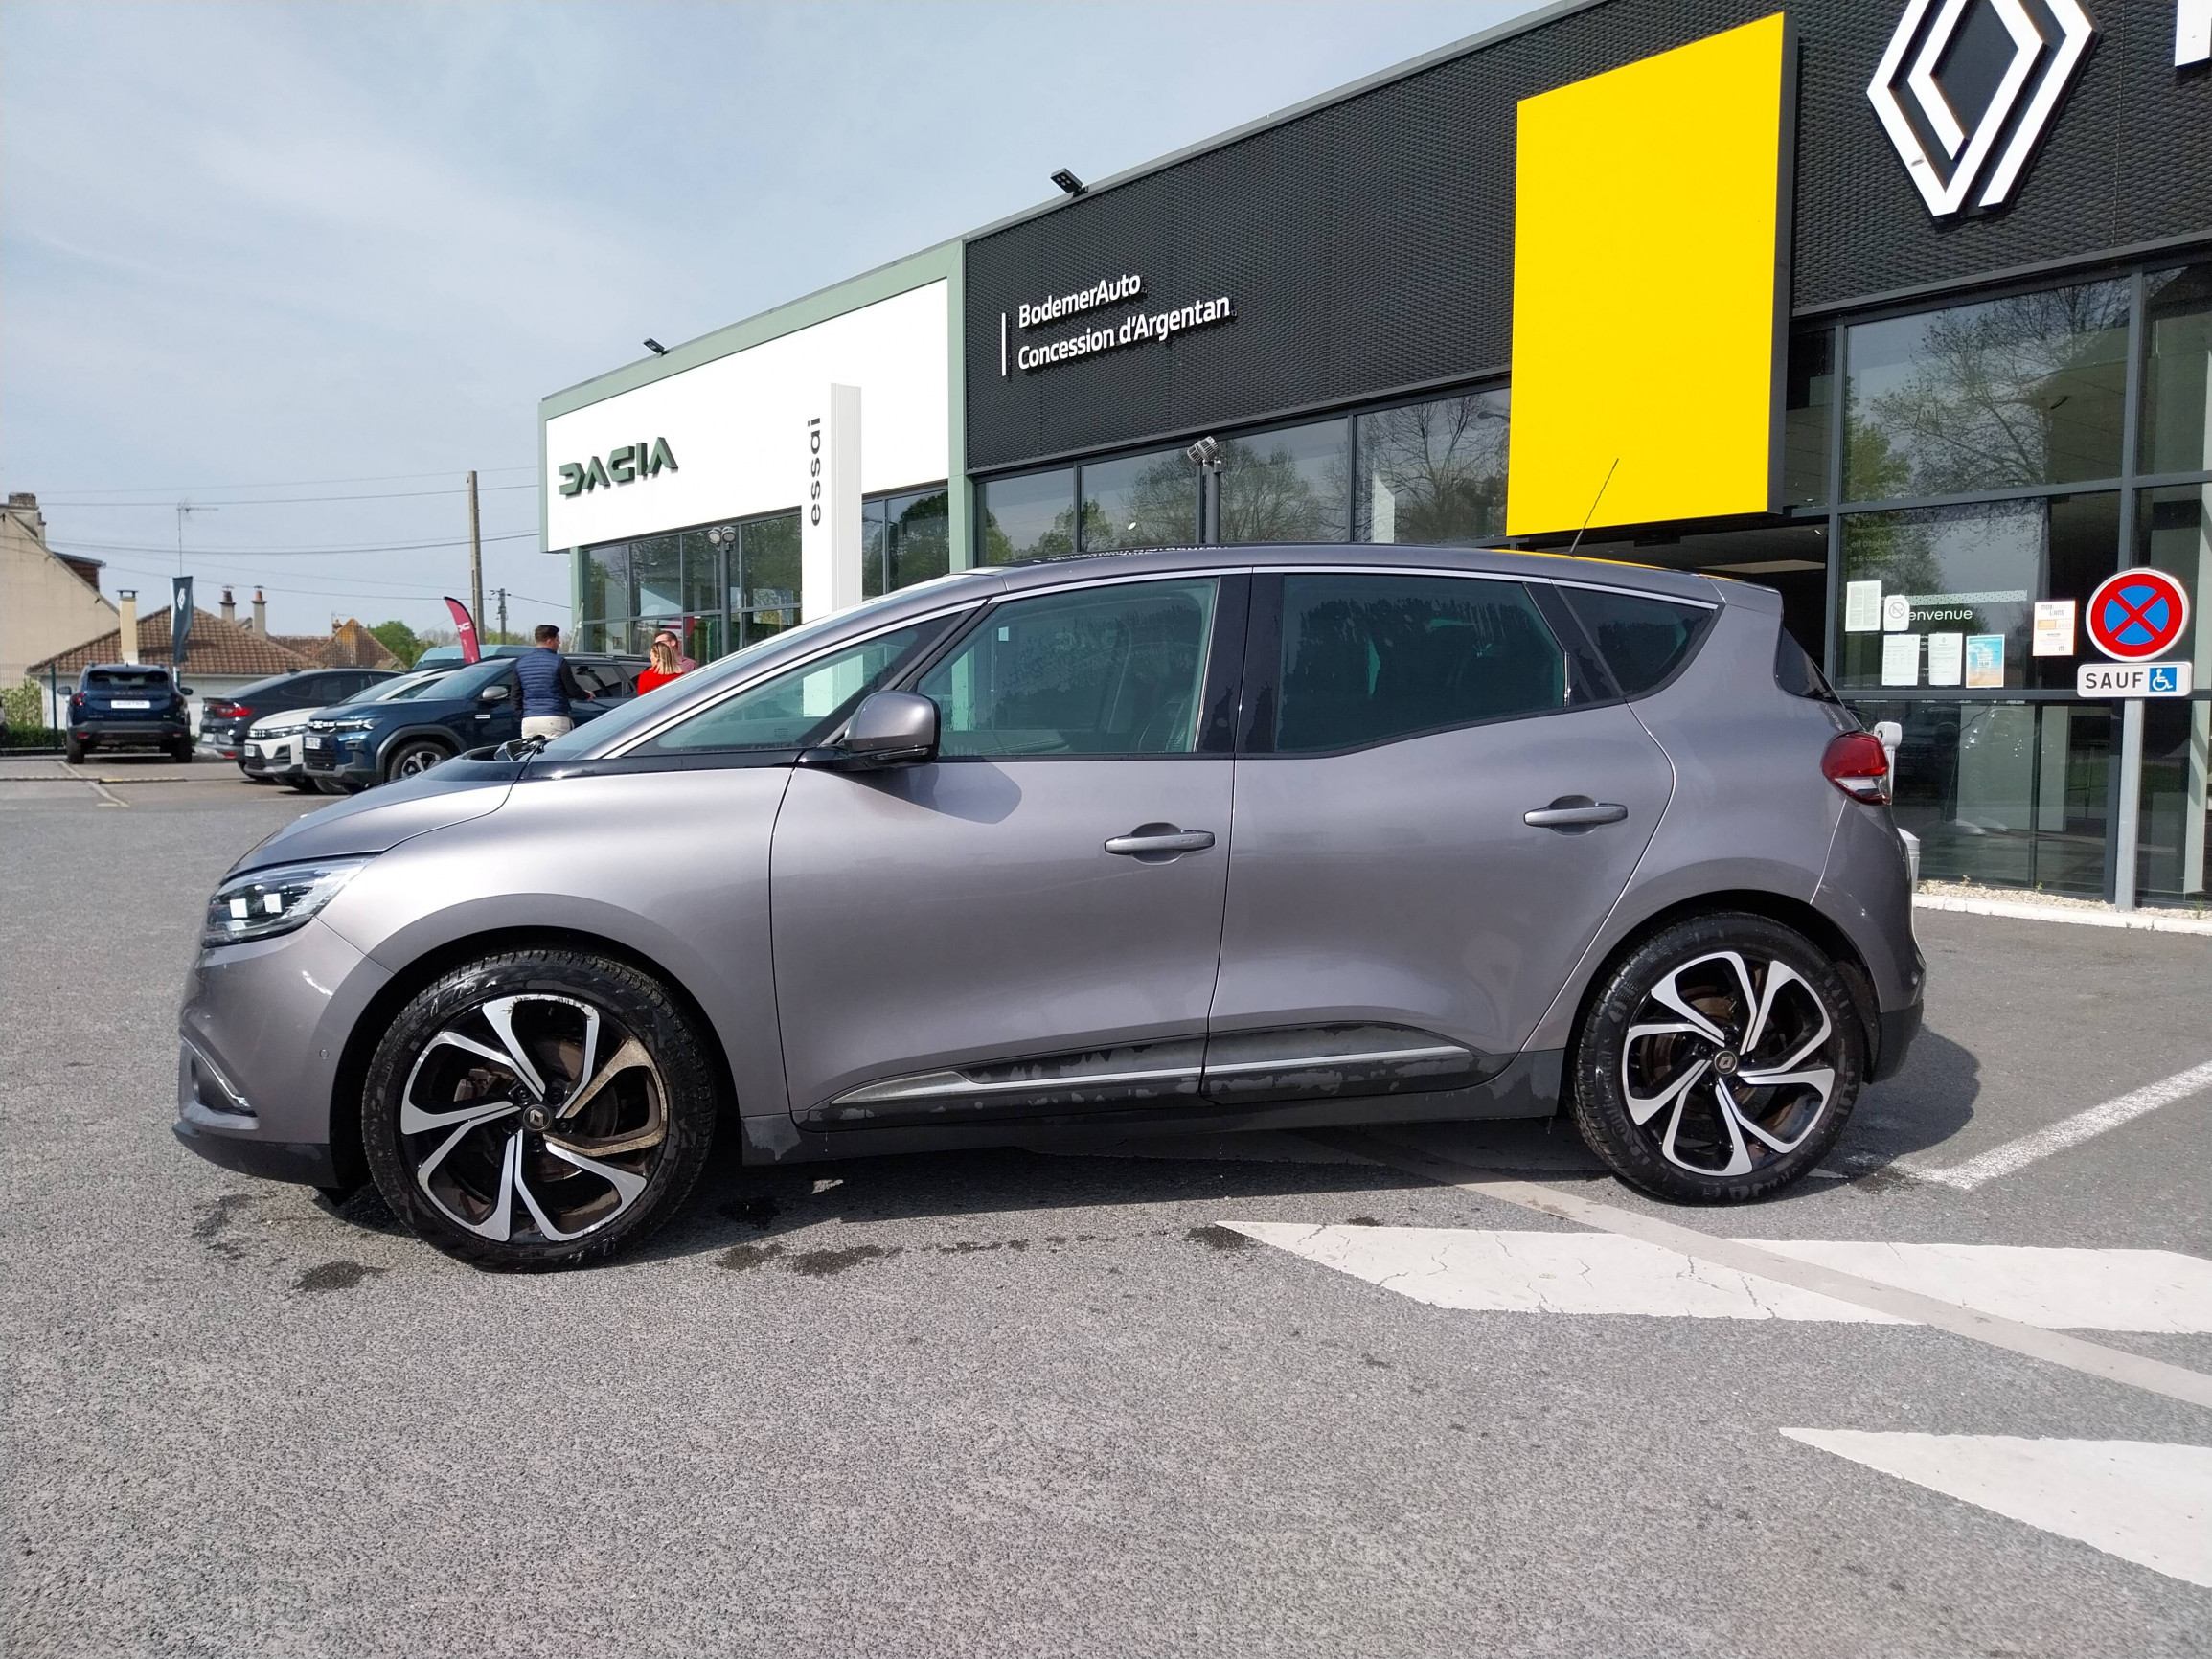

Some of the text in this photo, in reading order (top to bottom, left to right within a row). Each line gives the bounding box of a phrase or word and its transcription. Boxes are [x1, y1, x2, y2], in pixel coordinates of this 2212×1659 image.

[1018, 274, 1141, 328] BodemerAuto
[1018, 296, 1230, 370] Concession d'Argentan
[559, 436, 679, 497] DACIA
[807, 417, 821, 527] essai
[1909, 609, 1973, 621] envenue
[2085, 671, 2144, 689] SAUF
